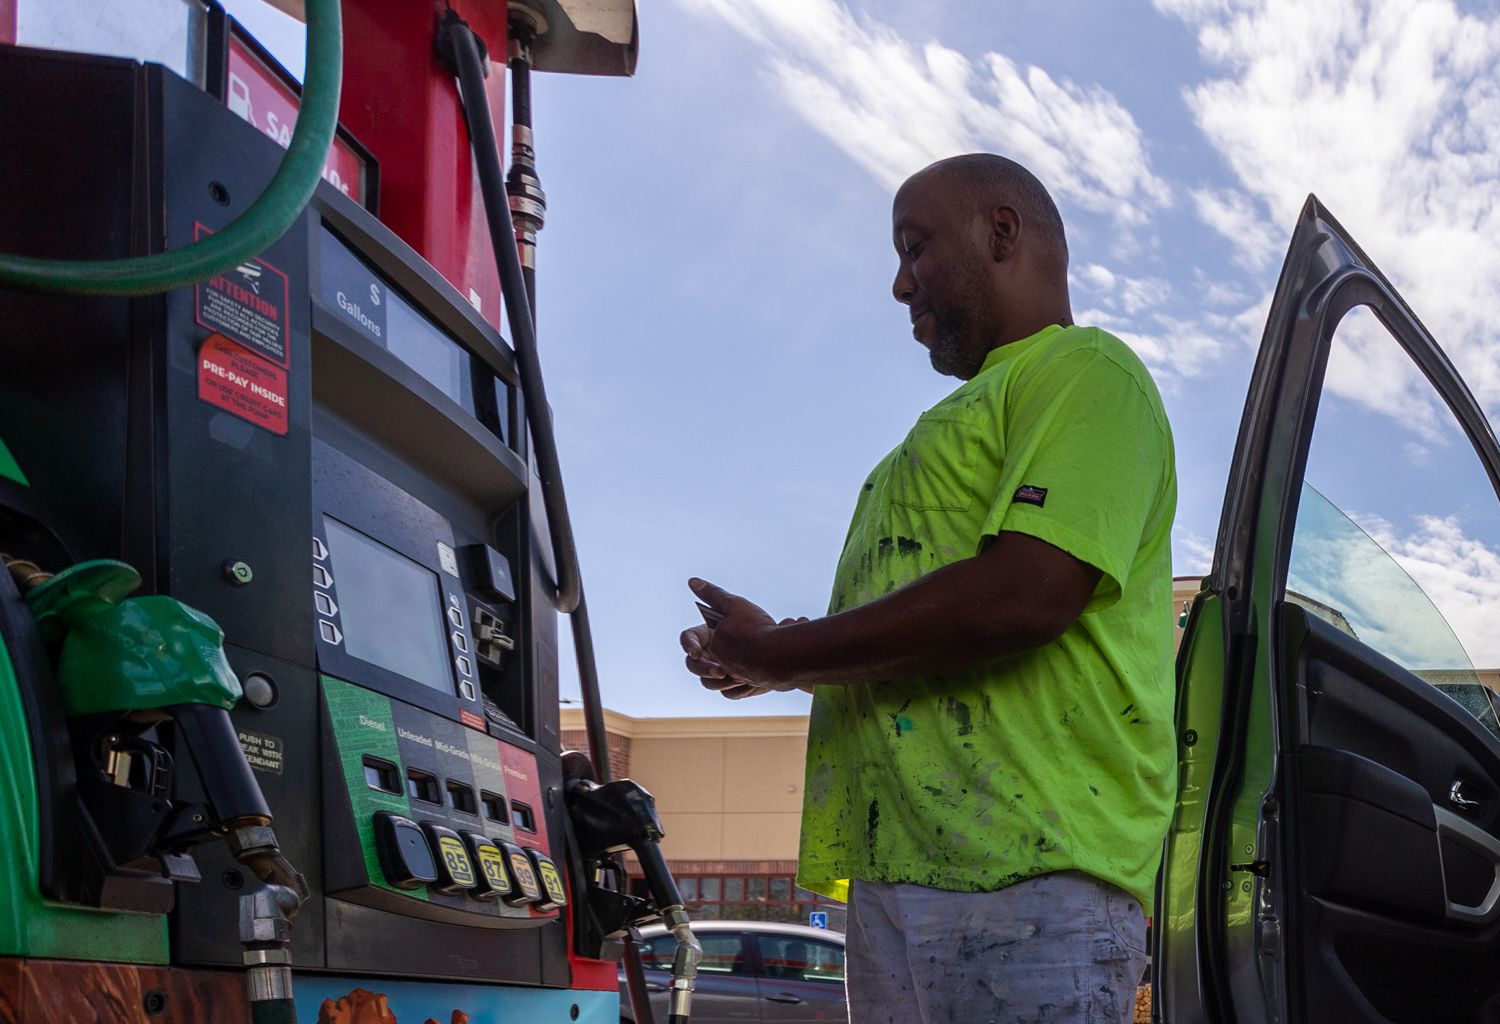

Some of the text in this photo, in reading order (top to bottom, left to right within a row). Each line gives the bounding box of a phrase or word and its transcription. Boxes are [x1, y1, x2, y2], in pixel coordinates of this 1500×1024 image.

[208, 276, 278, 320] ATTENTION
[336, 291, 382, 337] Gallons
[203, 359, 284, 407] PRE-PAY INSIDE
[360, 714, 386, 732] Diesel
[239, 733, 275, 749] PUSH TO
[397, 727, 433, 747] Unleaded
[240, 743, 282, 760] EAK WITH
[435, 740, 471, 760] Mid-Grade
[247, 754, 281, 769] ENDANT
[443, 850, 470, 876] 85
[483, 858, 503, 880] 87
[515, 866, 534, 888] 89
[544, 873, 561, 895] 91
